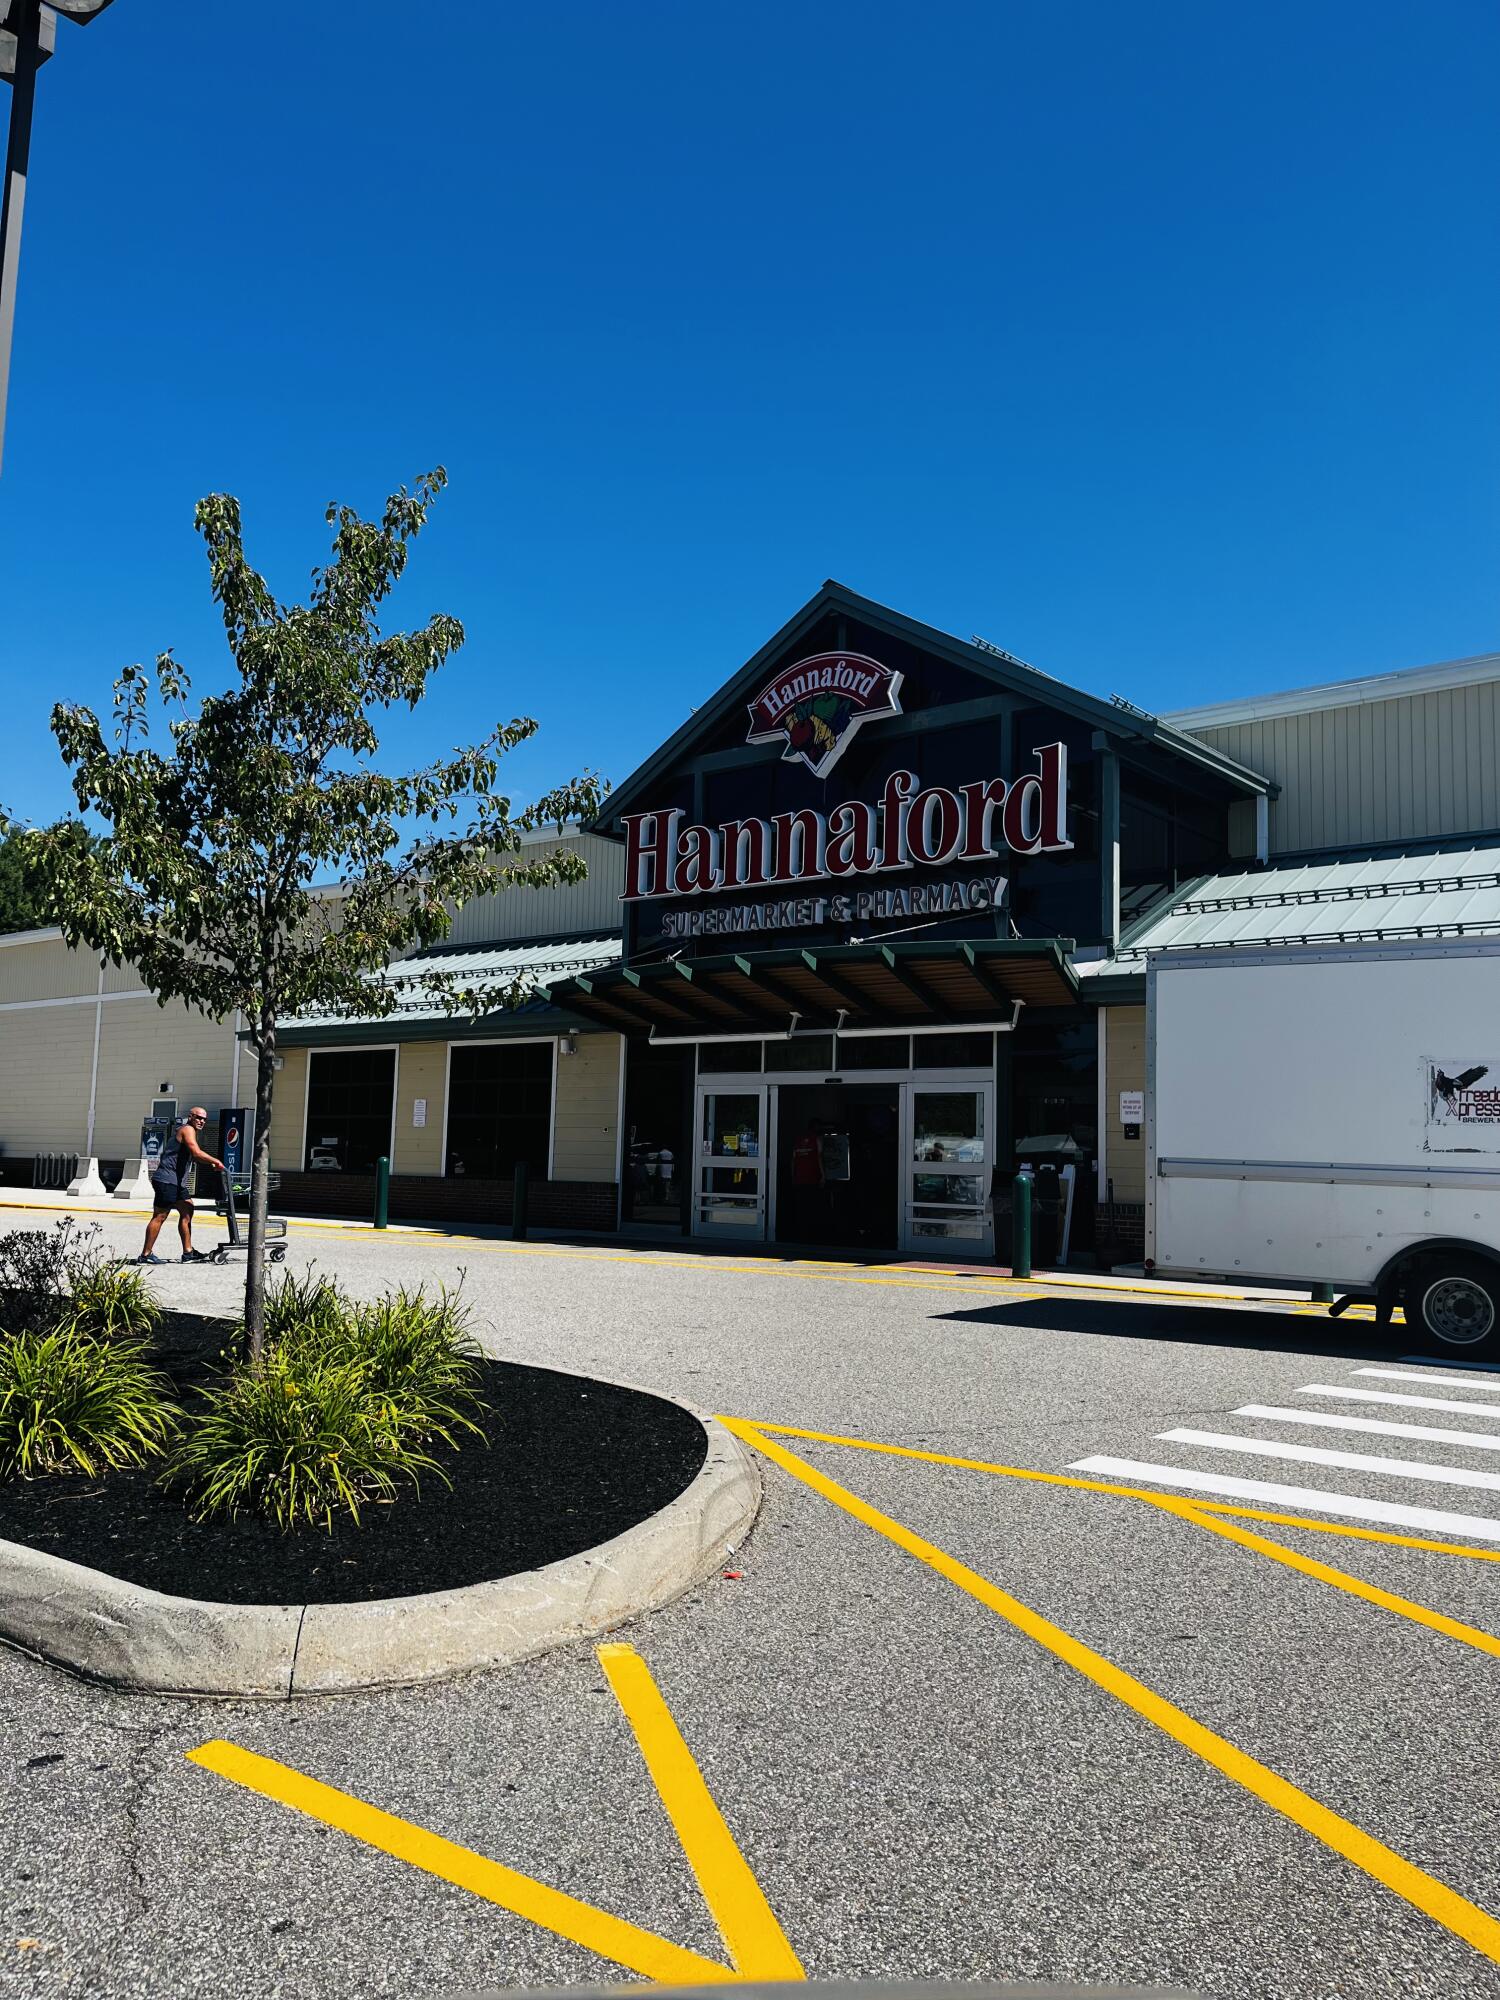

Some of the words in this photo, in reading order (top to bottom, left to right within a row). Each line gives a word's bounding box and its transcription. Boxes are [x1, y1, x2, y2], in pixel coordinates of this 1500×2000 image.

[761, 660, 881, 718] Hannaford
[617, 741, 1075, 901] Hannaford
[661, 898, 828, 938] SUPERMARKET
[830, 895, 851, 922] &
[856, 876, 1009, 920] PHARMACY
